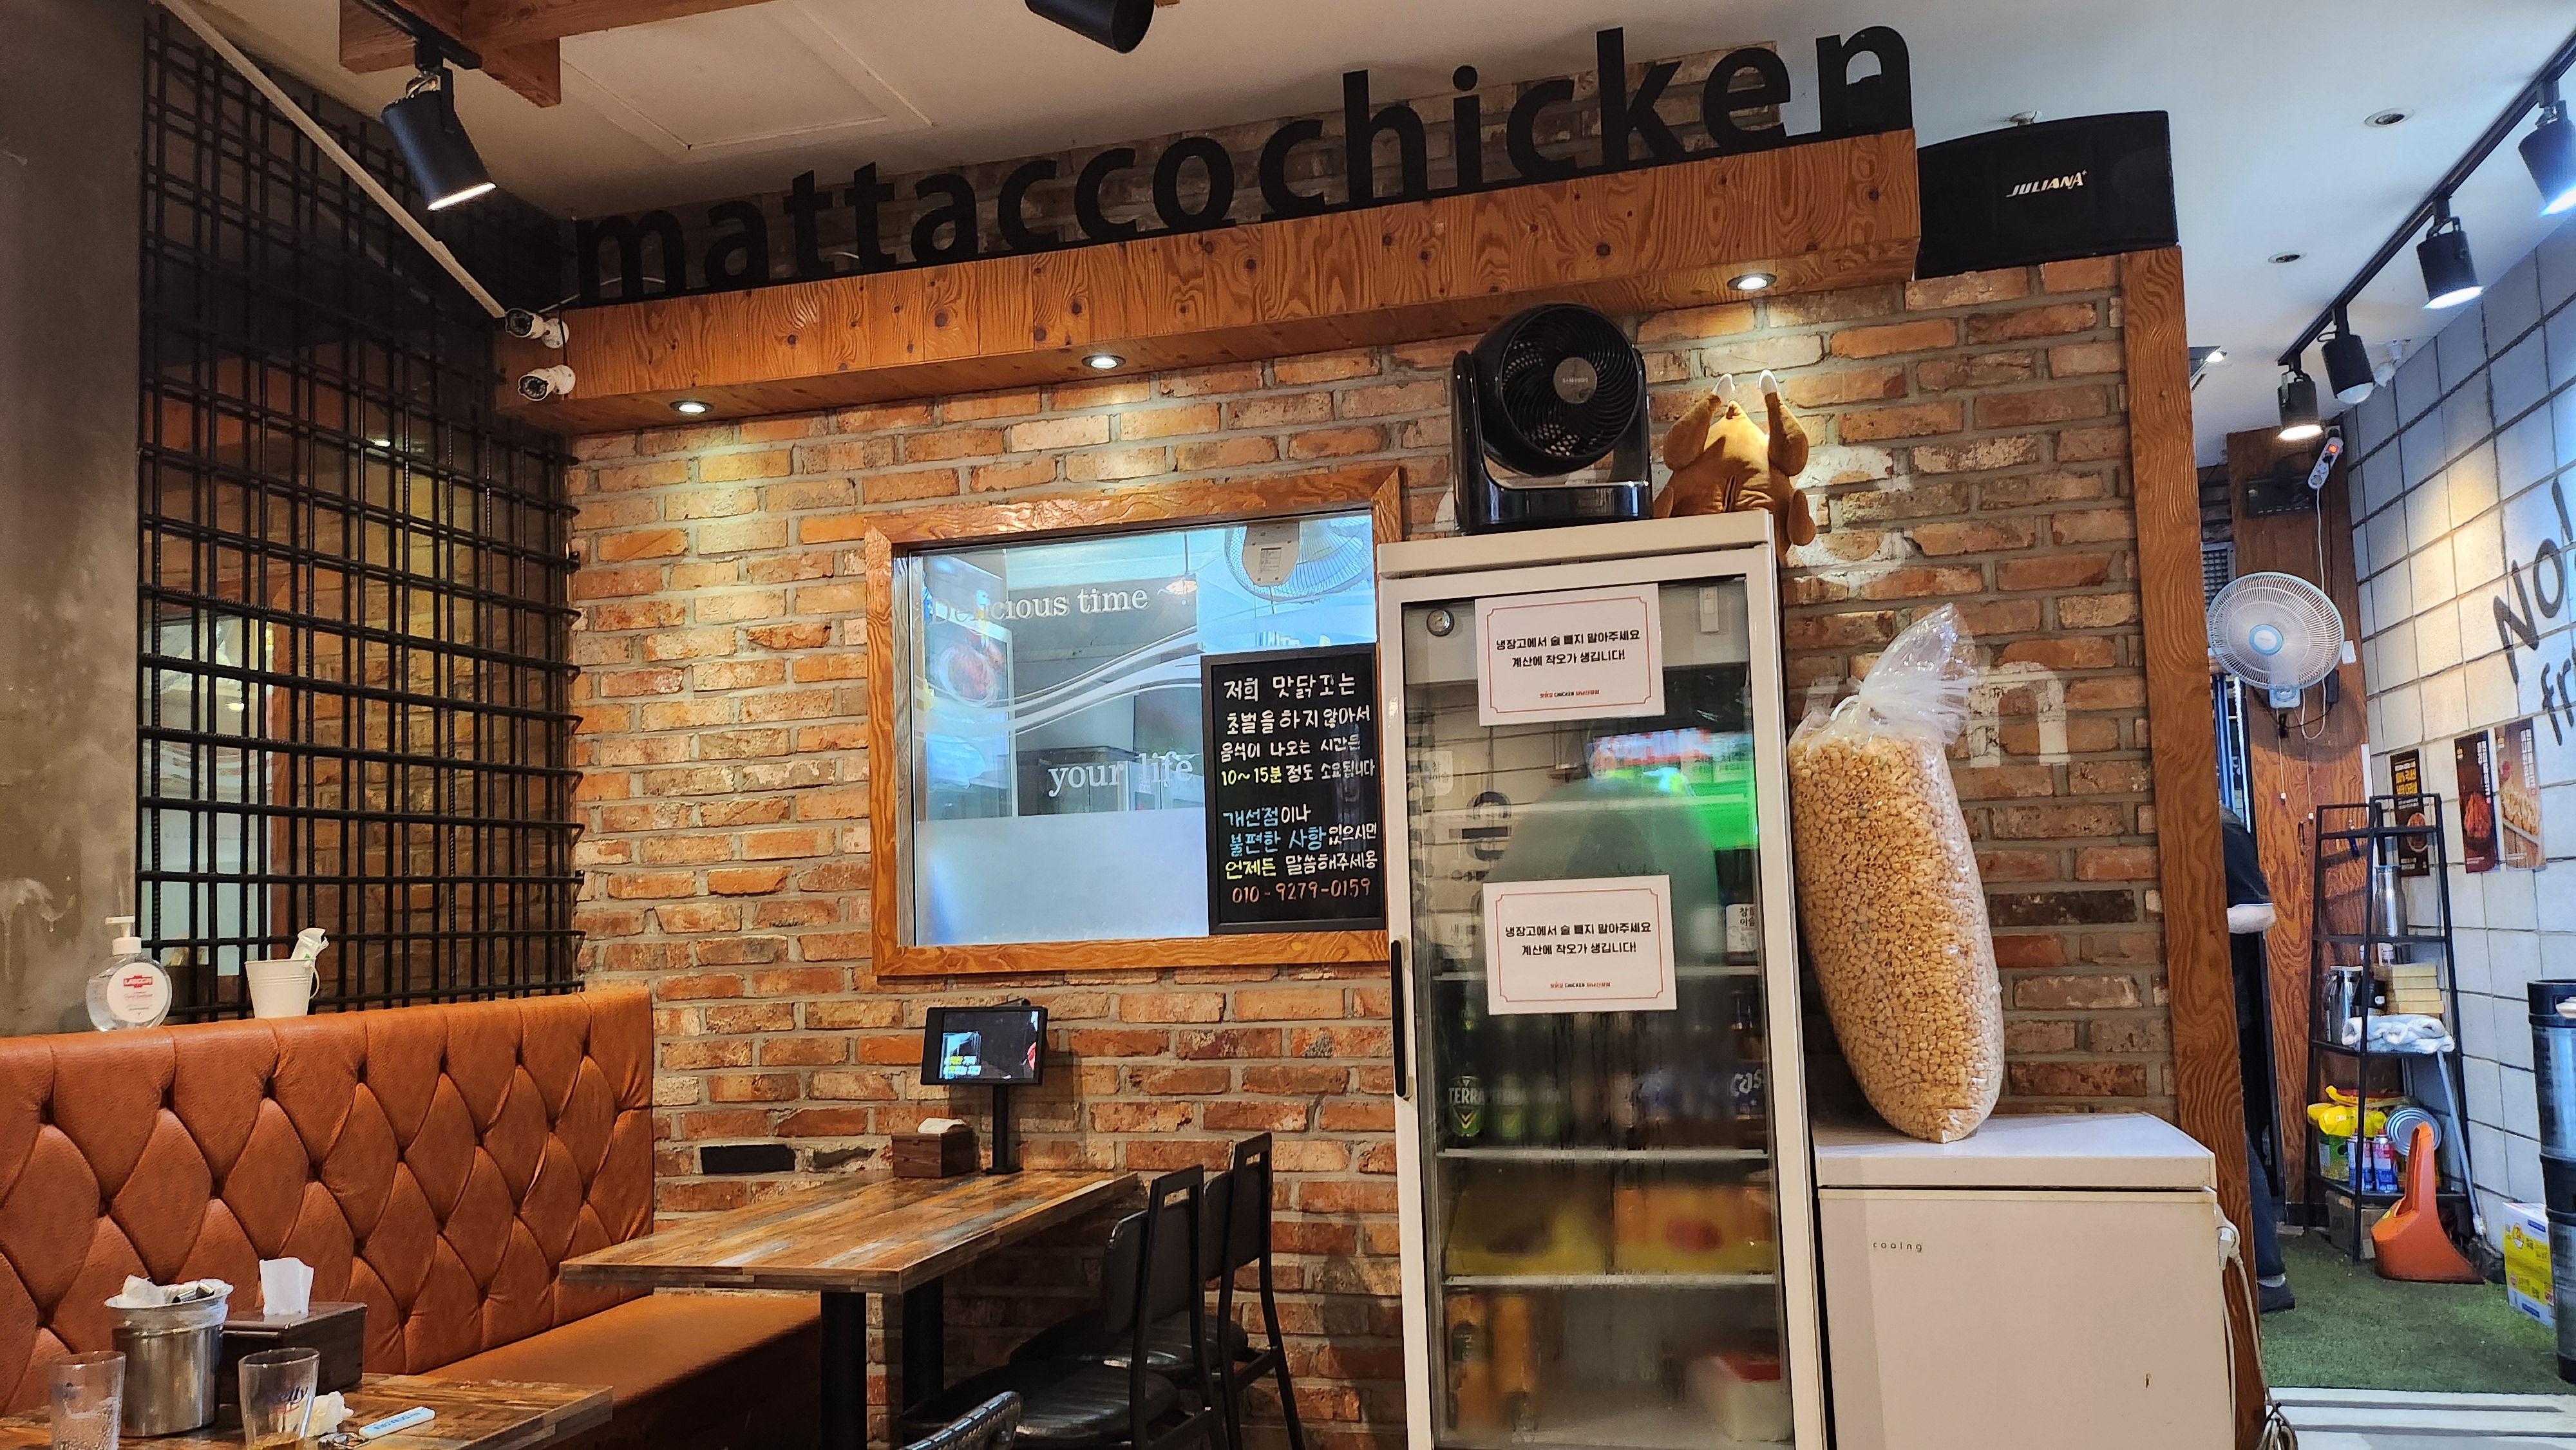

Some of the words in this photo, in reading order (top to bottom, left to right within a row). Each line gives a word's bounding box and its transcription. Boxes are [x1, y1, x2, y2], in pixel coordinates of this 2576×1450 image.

[2005, 171, 2084, 198] JULIANA
[1077, 587, 1150, 614] time
[1495, 636, 1547, 650] 냉장고에서
[1587, 629, 1640, 644] 말아주세요
[1511, 655, 1542, 667] 계산에
[1546, 652, 1577, 664] 착오가
[1580, 649, 1625, 663] 생깁니다!
[1224, 677, 1258, 702] 저희
[1220, 742, 1260, 763] 음식이
[1270, 739, 1311, 757] 나오는
[1320, 733, 1361, 751] 시간은
[1048, 761, 1124, 797] your
[1134, 751, 1194, 783] life
[1285, 763, 1314, 784] 정도
[1320, 758, 1376, 780] 소요됩니다
[1222, 803, 1312, 827] 개선점이나
[1229, 830, 1282, 858] 불편한
[1225, 857, 1277, 880] 언제든
[1505, 925, 1557, 937] 냉장고에서
[1598, 921, 1651, 934] 말아주세요
[1522, 944, 1553, 956] 계산에
[1556, 943, 1587, 955] 착오가
[1590, 941, 1636, 954] 생깁니다!
